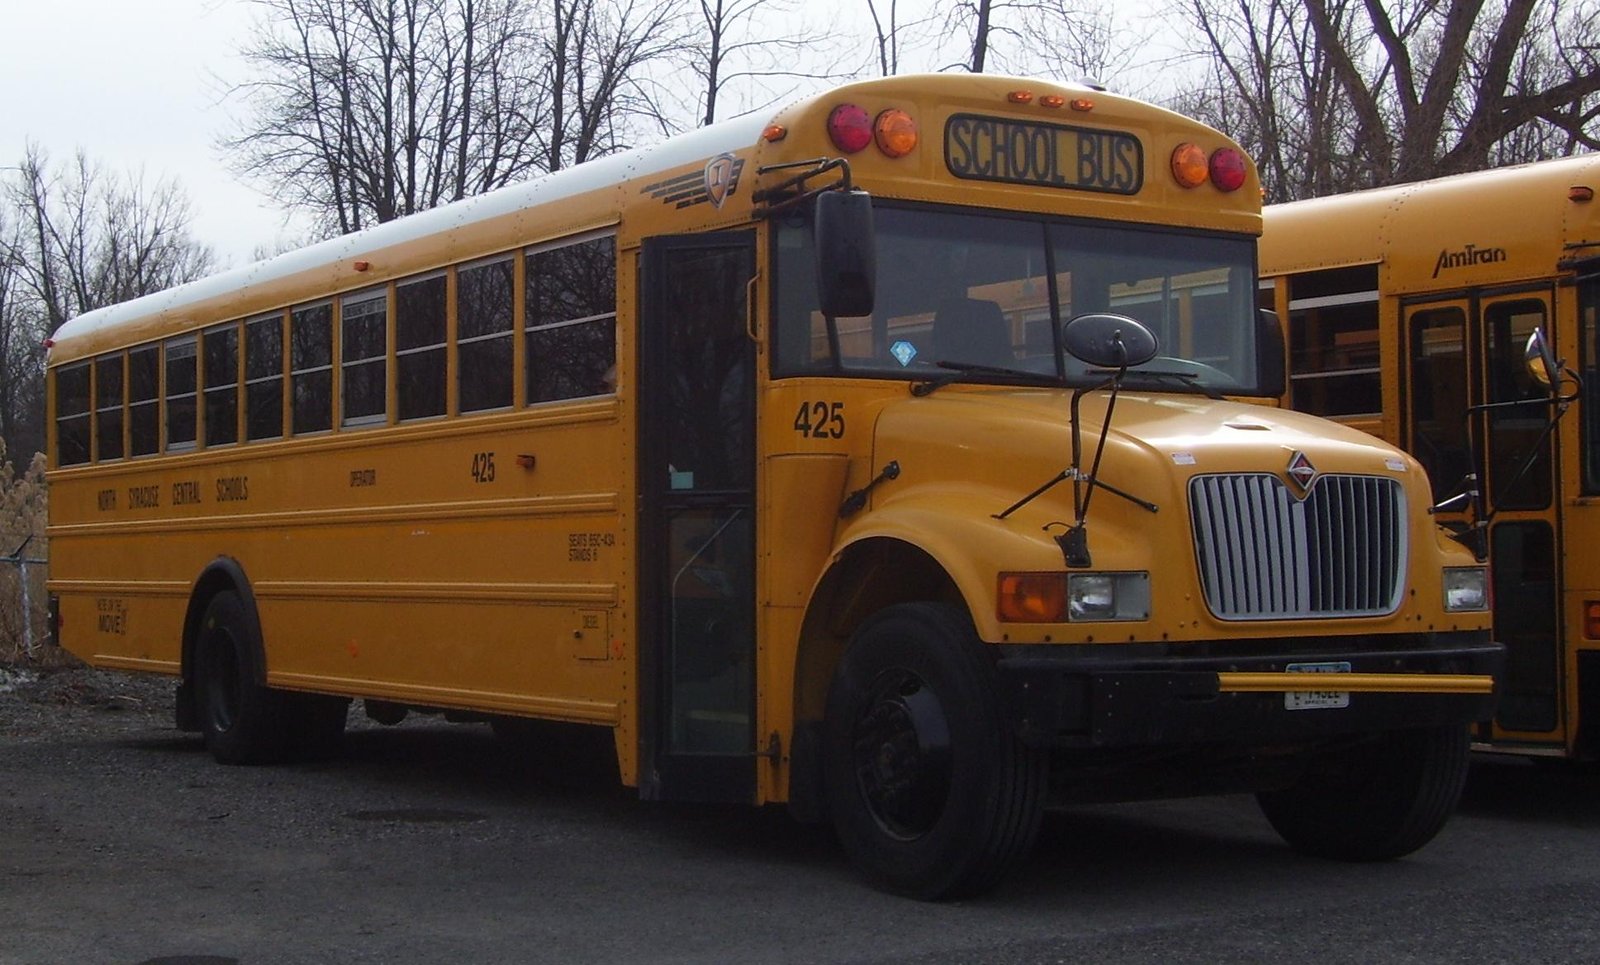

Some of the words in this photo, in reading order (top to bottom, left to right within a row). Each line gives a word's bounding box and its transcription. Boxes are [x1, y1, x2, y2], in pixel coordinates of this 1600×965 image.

[950, 118, 1065, 184] SCHOOL
[1077, 133, 1133, 191] BUS
[1432, 243, 1507, 279] AmTran
[794, 401, 845, 439] 425
[471, 452, 495, 483] 425
[97, 490, 116, 511] NORTH
[128, 485, 159, 509] SYRACUSE
[172, 481, 202, 504] CENTRAL
[216, 477, 248, 501] SCHOOLS
